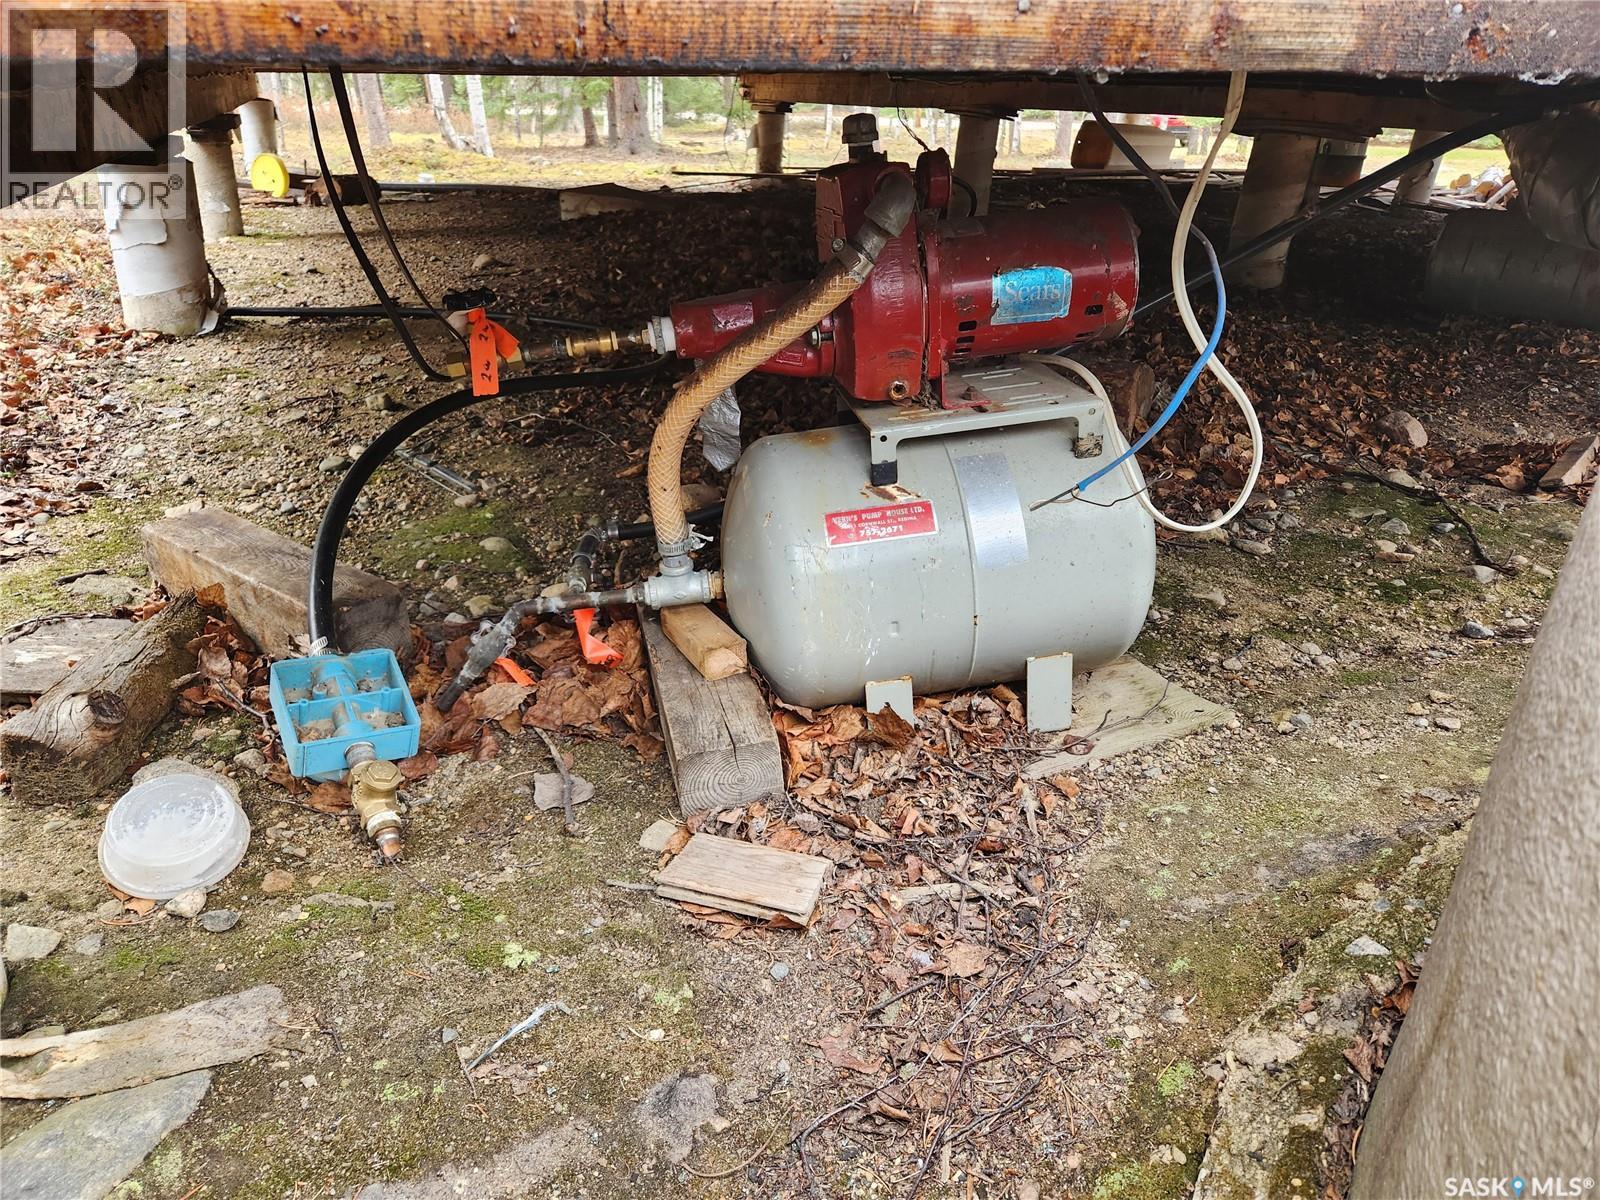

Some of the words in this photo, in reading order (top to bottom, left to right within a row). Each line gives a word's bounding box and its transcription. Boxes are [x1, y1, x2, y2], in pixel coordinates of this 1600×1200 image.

[1005, 280, 1061, 303] Sears
[861, 512, 882, 520] PUMP
[886, 508, 908, 516] HOUSE
[910, 506, 925, 514] LTD.
